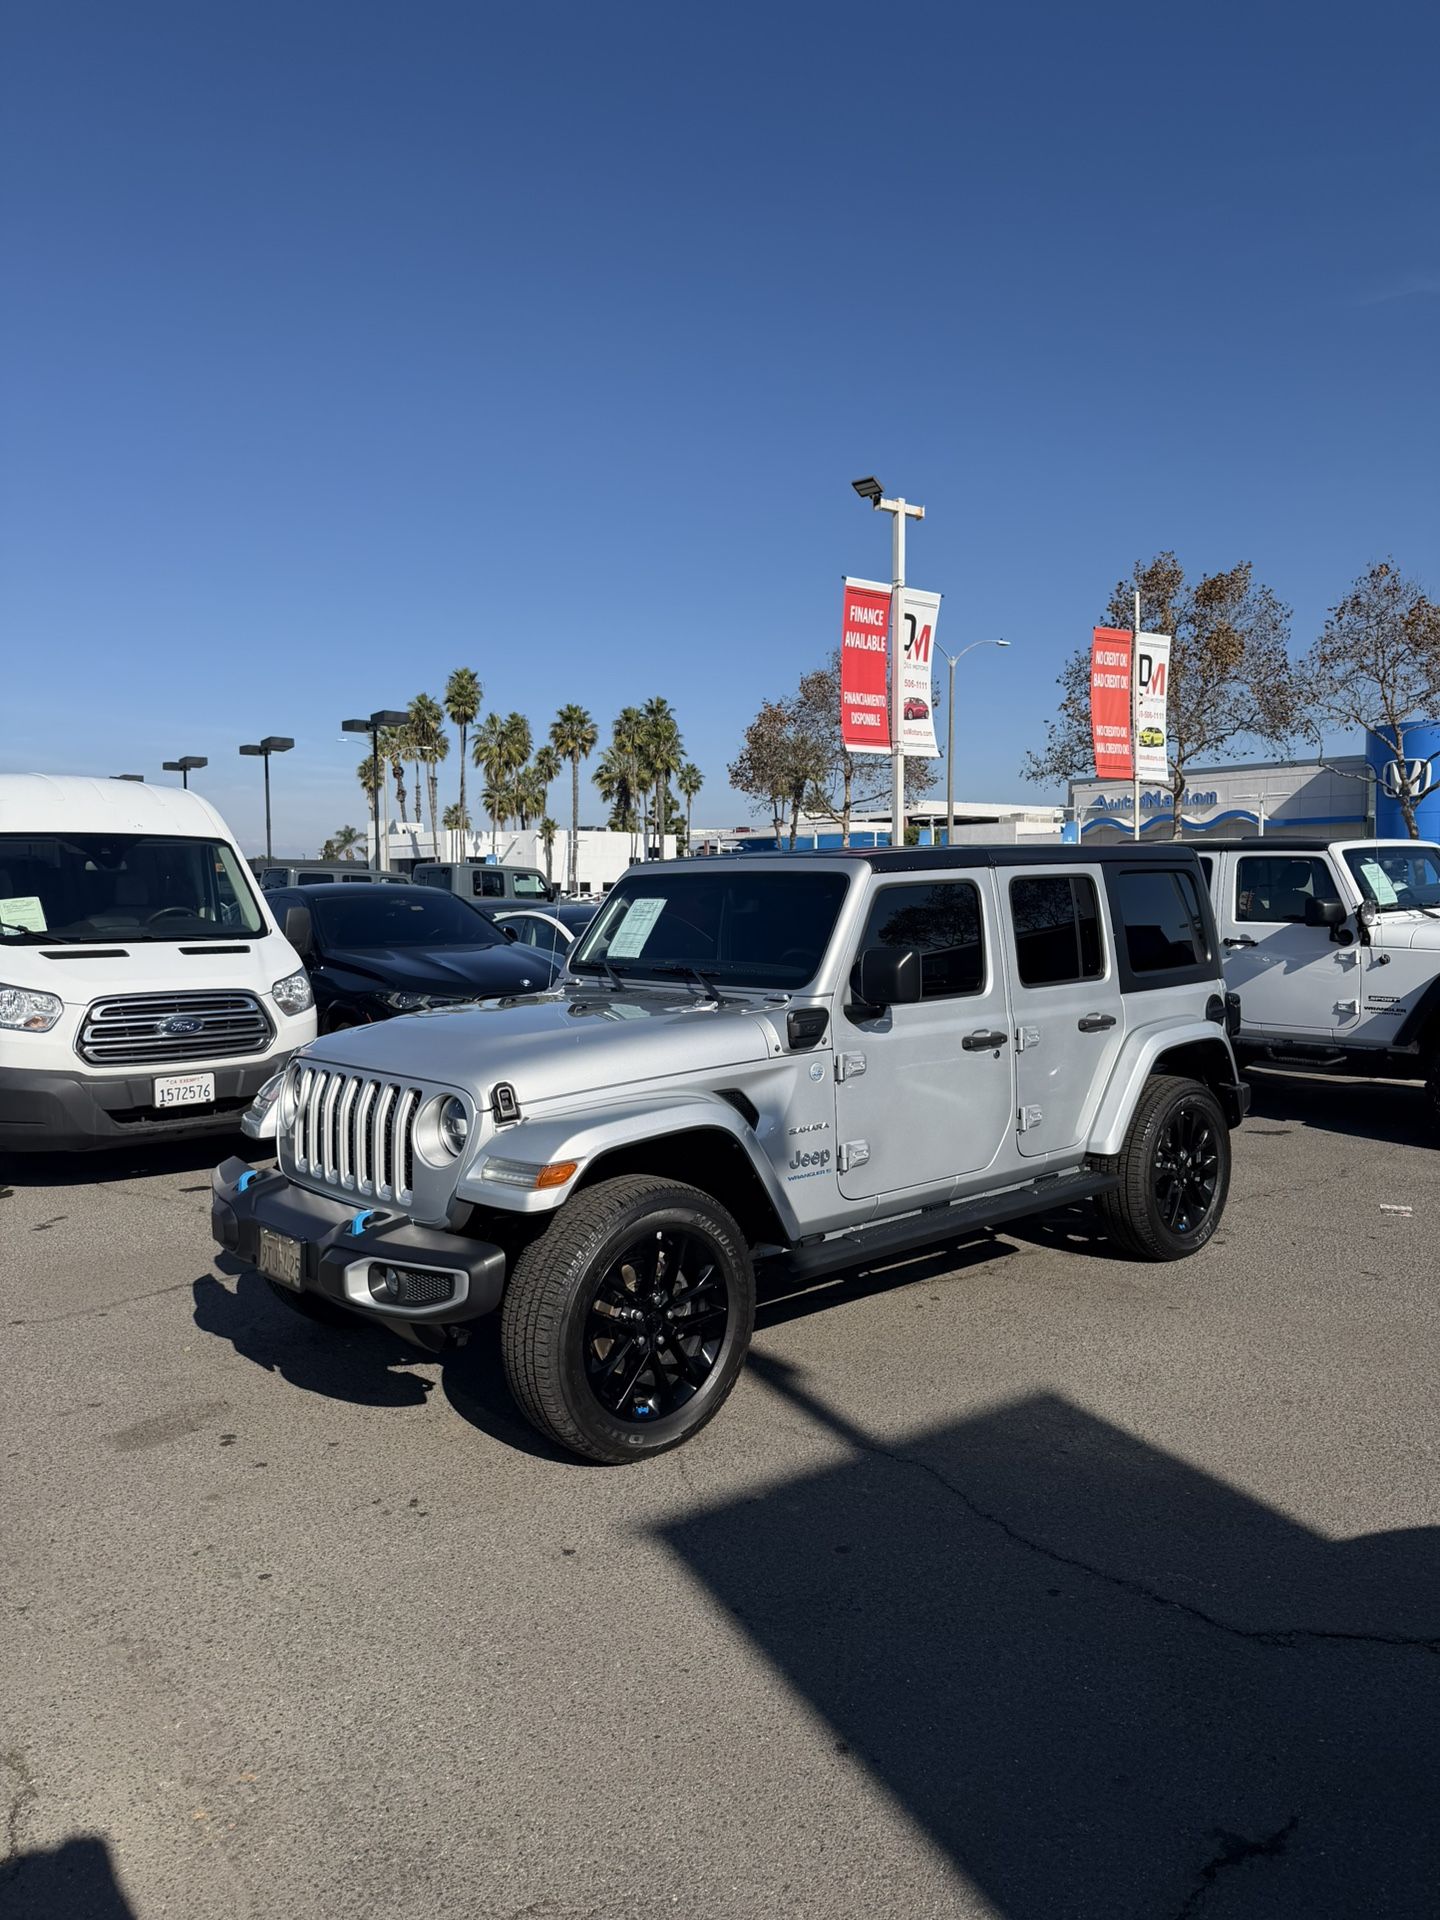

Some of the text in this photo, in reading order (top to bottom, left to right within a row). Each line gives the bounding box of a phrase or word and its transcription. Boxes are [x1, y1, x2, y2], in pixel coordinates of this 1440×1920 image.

[850, 604, 884, 626] FINANCE
[844, 631, 886, 652] AVAILABLE
[1095, 650, 1104, 665] NO
[1104, 651, 1120, 667] CREDIT
[1093, 672, 1104, 688] BAD
[1104, 673, 1120, 689] CREDIT
[843, 691, 886, 707] FINANCIAMENTO
[850, 711, 881, 727] DISPONIBLE
[1096, 724, 1104, 736] NO
[1090, 787, 1218, 811] AutoNaion
[1368, 995, 1400, 1003] SPORT
[170, 1020, 195, 1032] Ford
[160, 1083, 211, 1103] 1572576
[788, 1121, 830, 1136] SAHARA
[789, 1149, 831, 1170] Jeep
[787, 1169, 826, 1182] WRANGLER
